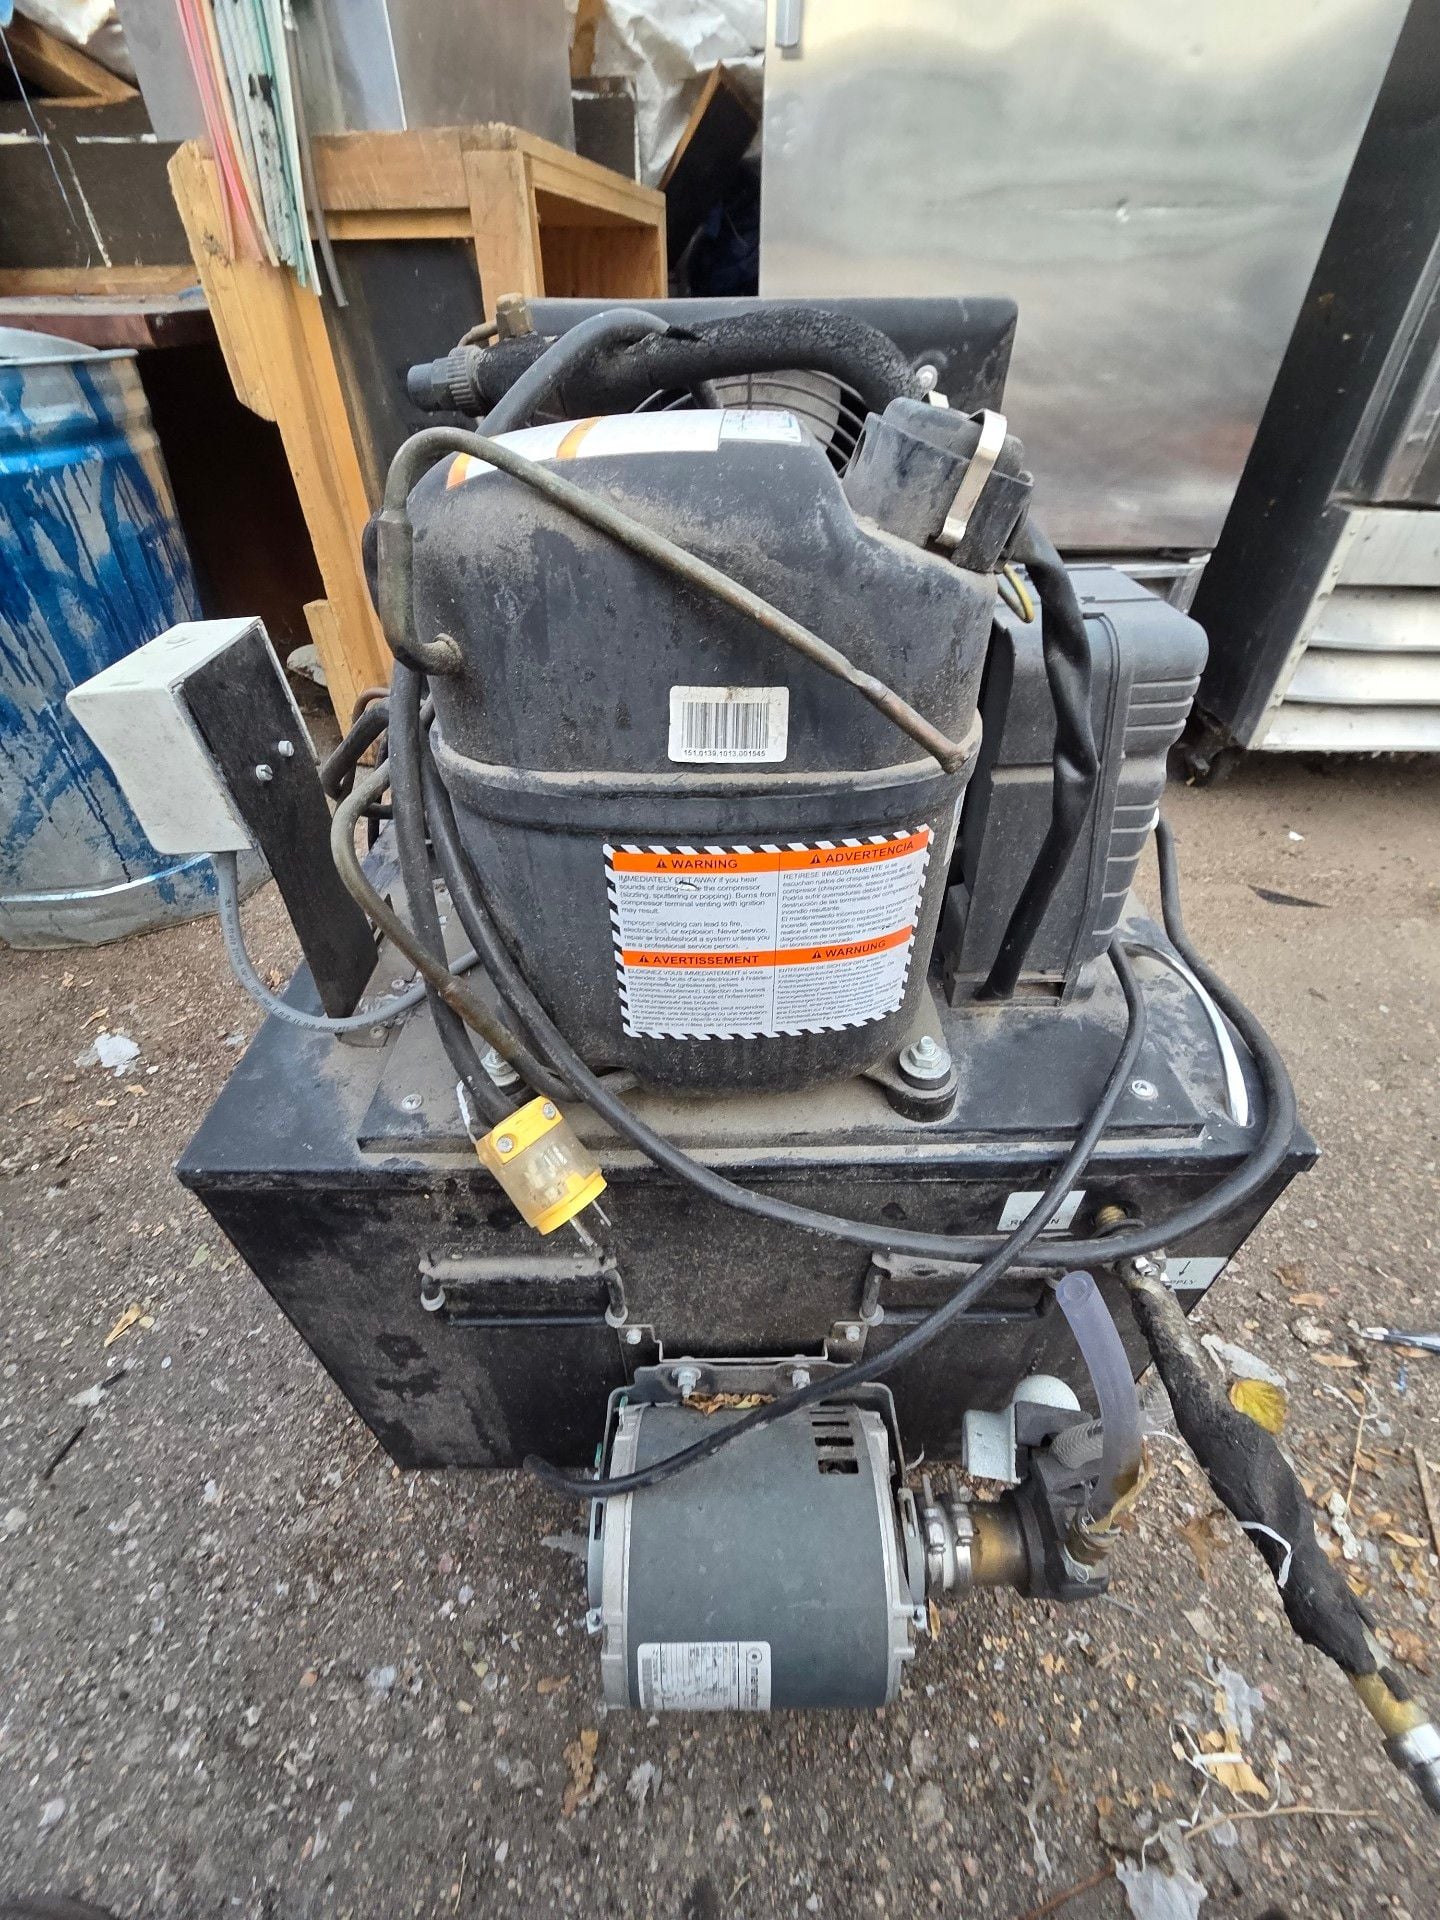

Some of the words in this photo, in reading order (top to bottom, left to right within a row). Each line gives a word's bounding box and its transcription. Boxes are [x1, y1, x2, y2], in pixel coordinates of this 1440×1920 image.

[826, 841, 914, 863] ADVERTENCIA
[672, 860, 738, 868] WARNING
[618, 874, 674, 883] IMMEDIATELY
[656, 884, 679, 892] arcing
[653, 892, 688, 900] sputtering
[620, 899, 663, 908] compressor
[695, 900, 722, 908] venting
[740, 899, 766, 907] ignition
[623, 920, 654, 928] Improper
[624, 934, 644, 942] repair
[644, 942, 686, 950] professional
[826, 940, 886, 958] WARNUNG
[653, 955, 760, 964] AVERTISSEMENT
